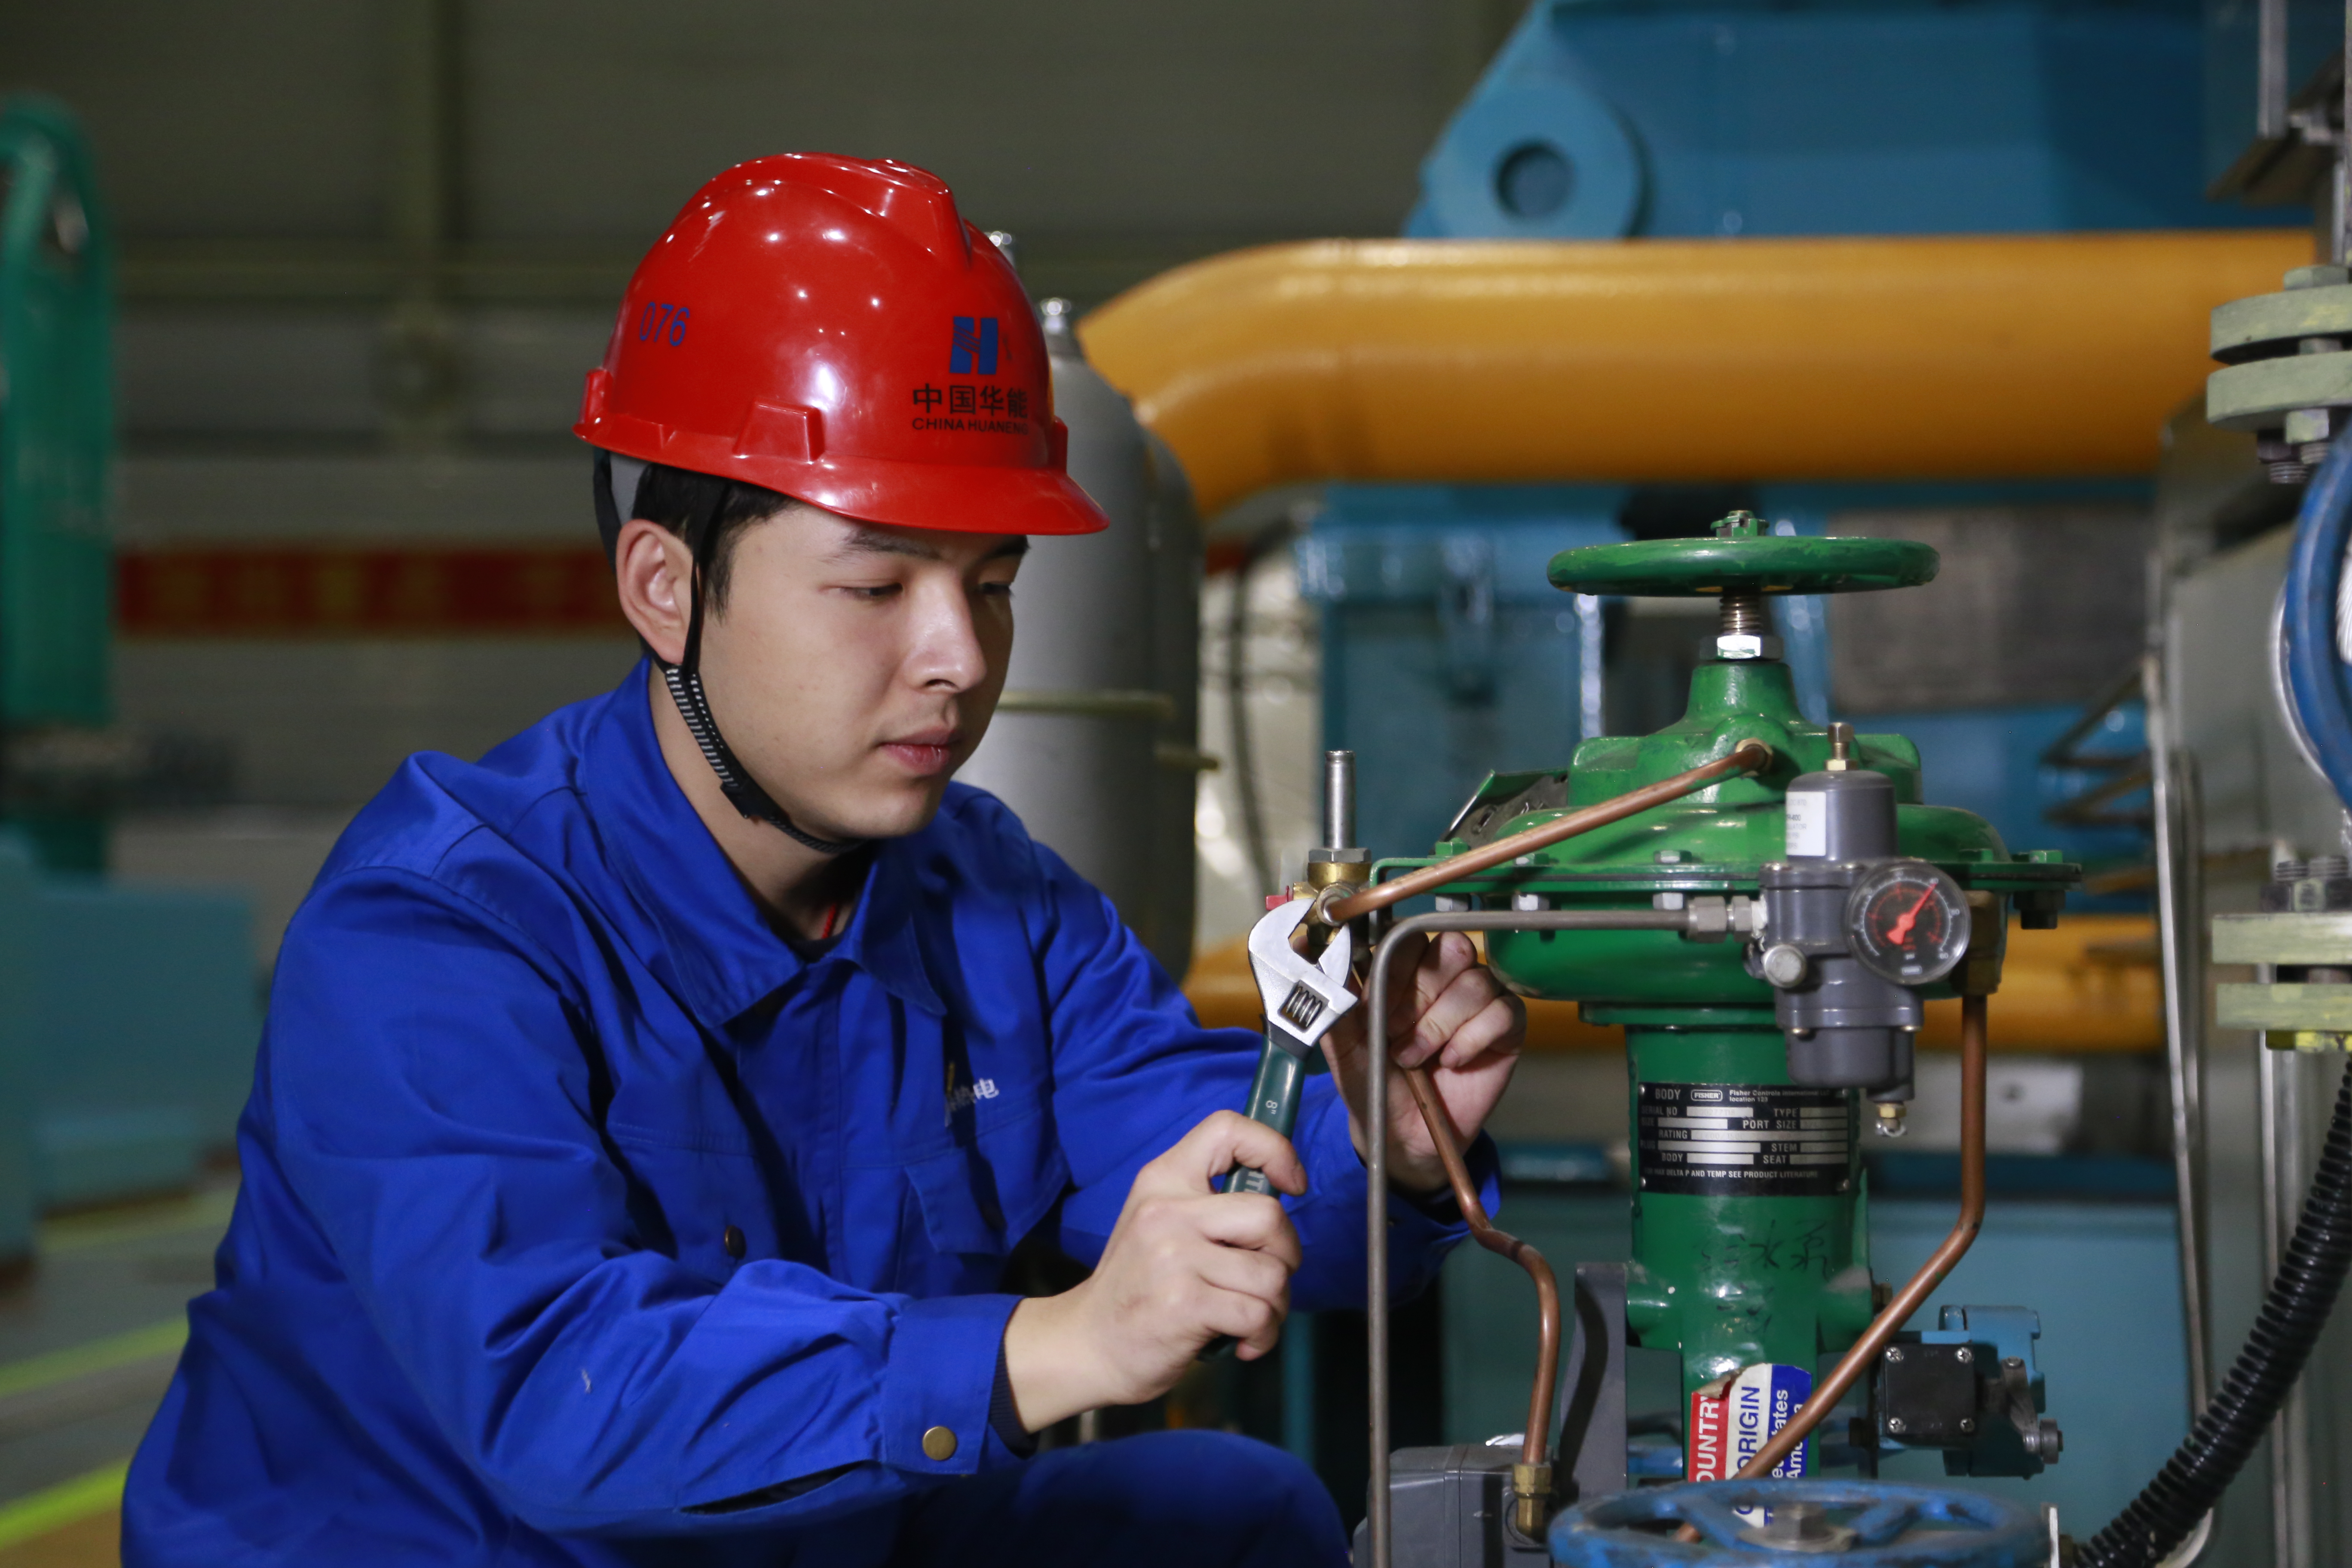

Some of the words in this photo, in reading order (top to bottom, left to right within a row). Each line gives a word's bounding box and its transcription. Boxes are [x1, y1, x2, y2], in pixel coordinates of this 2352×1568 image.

[640, 301, 690, 346] 076
[913, 383, 1028, 419] 中国华能
[912, 418, 965, 431] CHINA
[968, 420, 1029, 435] HUANENG
[1655, 1088, 1681, 1100] BODY
[1641, 1106, 1664, 1116] SERIAL
[1666, 1106, 1678, 1116] NO
[1773, 1108, 1798, 1118] TYPE
[1641, 1117, 1655, 1126] SIZE
[1742, 1120, 1770, 1129] PORT
[1776, 1119, 1798, 1130] SIZE
[1658, 1129, 1688, 1140] RATING
[1771, 1142, 1798, 1152] STEM
[1661, 1152, 1684, 1163] BODY
[1762, 1155, 1787, 1164] SEAT
[1666, 1168, 1684, 1176] DELTA
[1685, 1169, 1690, 1177] P
[1690, 1169, 1706, 1178] AND
[1707, 1170, 1727, 1179] TEMP
[1728, 1170, 1742, 1179] SEE
[1743, 1170, 1778, 1179] PRODUCT
[1696, 1395, 1719, 1483] OUNTR
